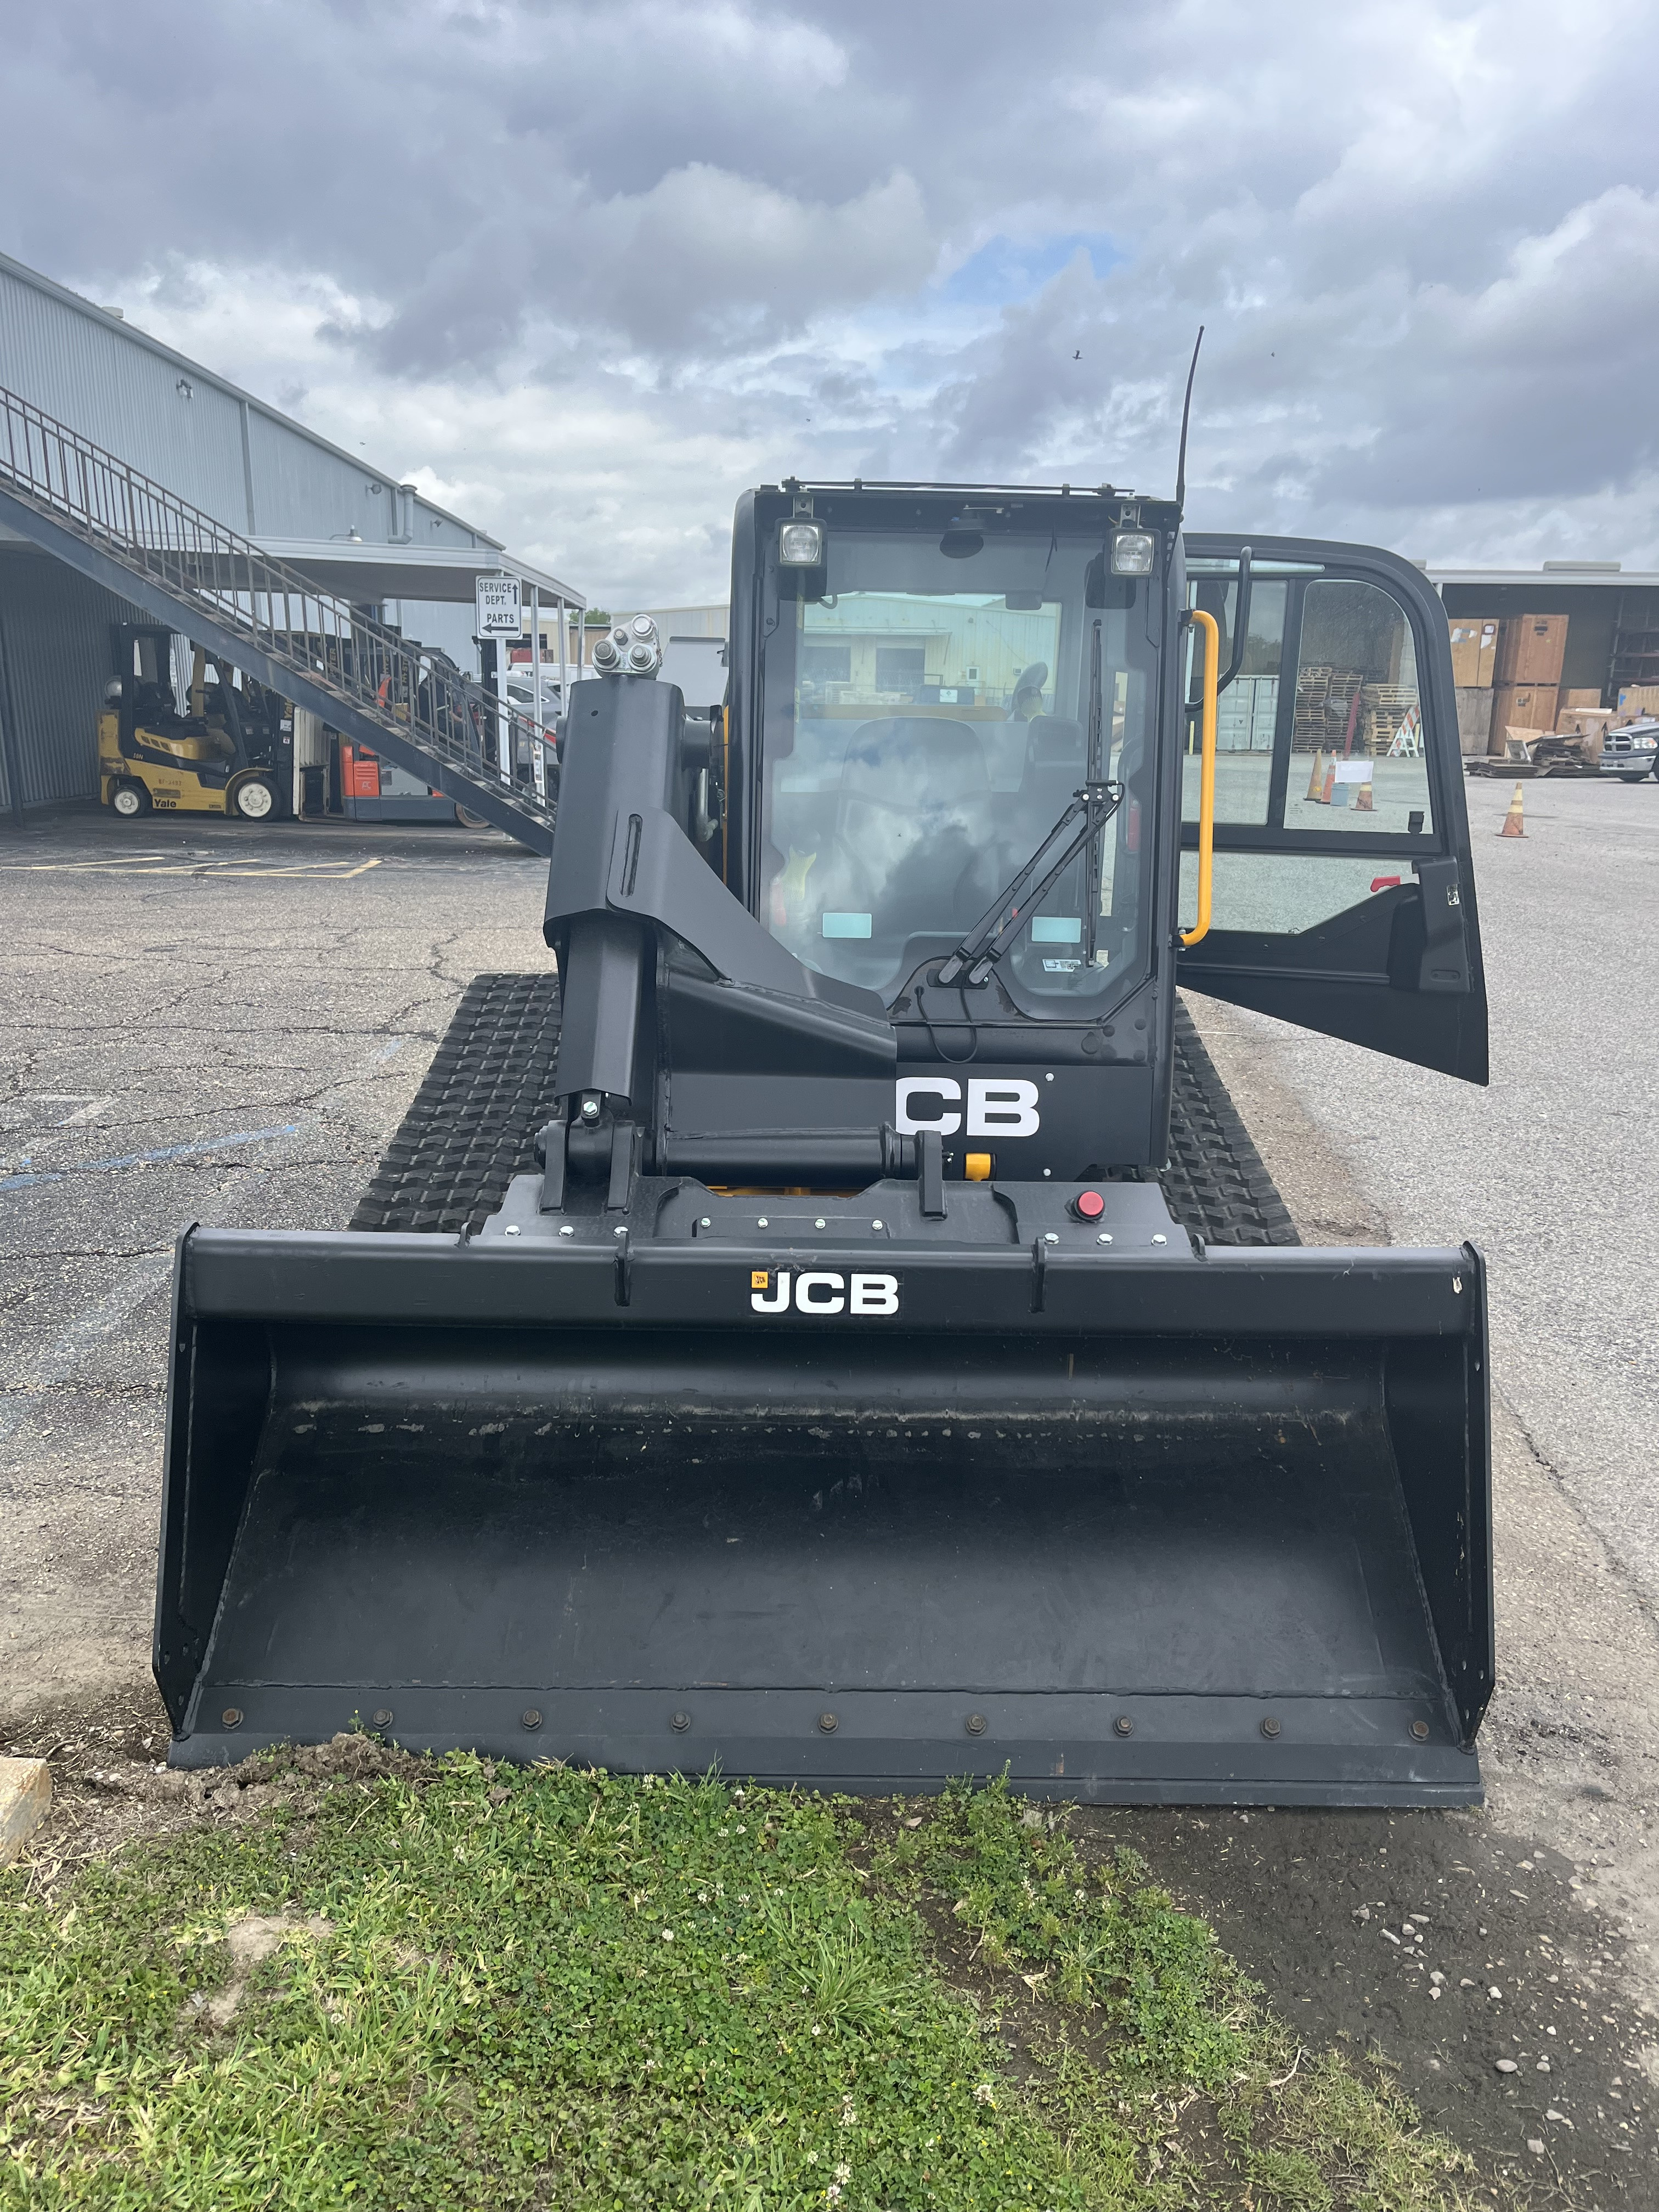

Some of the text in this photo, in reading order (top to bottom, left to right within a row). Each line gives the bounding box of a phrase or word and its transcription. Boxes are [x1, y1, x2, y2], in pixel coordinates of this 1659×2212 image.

[479, 583, 511, 593] SERVICE
[486, 595, 506, 605] DEPT.
[487, 613, 514, 624] PARTS
[154, 799, 177, 808] Yale
[896, 1077, 1040, 1137] CB
[752, 1272, 899, 1314] JCB
